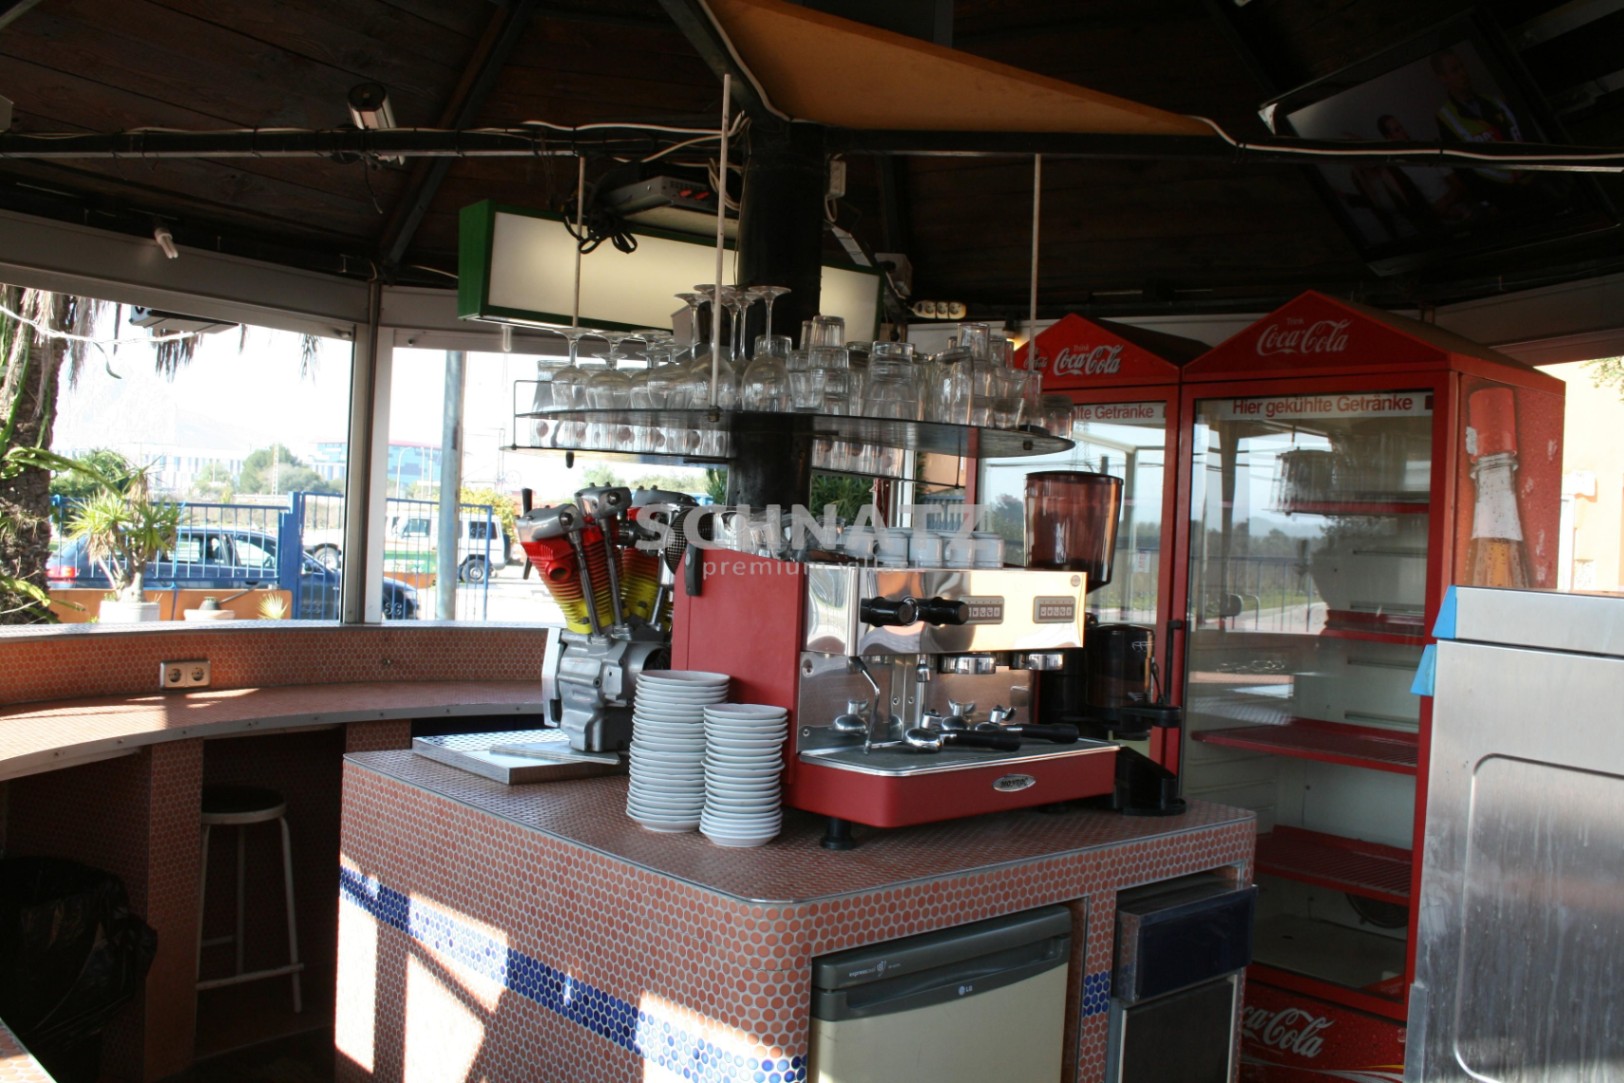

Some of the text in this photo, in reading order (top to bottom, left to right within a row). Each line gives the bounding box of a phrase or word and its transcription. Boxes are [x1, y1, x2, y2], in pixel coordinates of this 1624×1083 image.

[1053, 344, 1124, 376] Coca-Cola
[1094, 405, 1154, 420] Getränke
[1232, 395, 1414, 418] Hier gekühlte Getränke
[1242, 1007, 1336, 1058] ca-Cola
